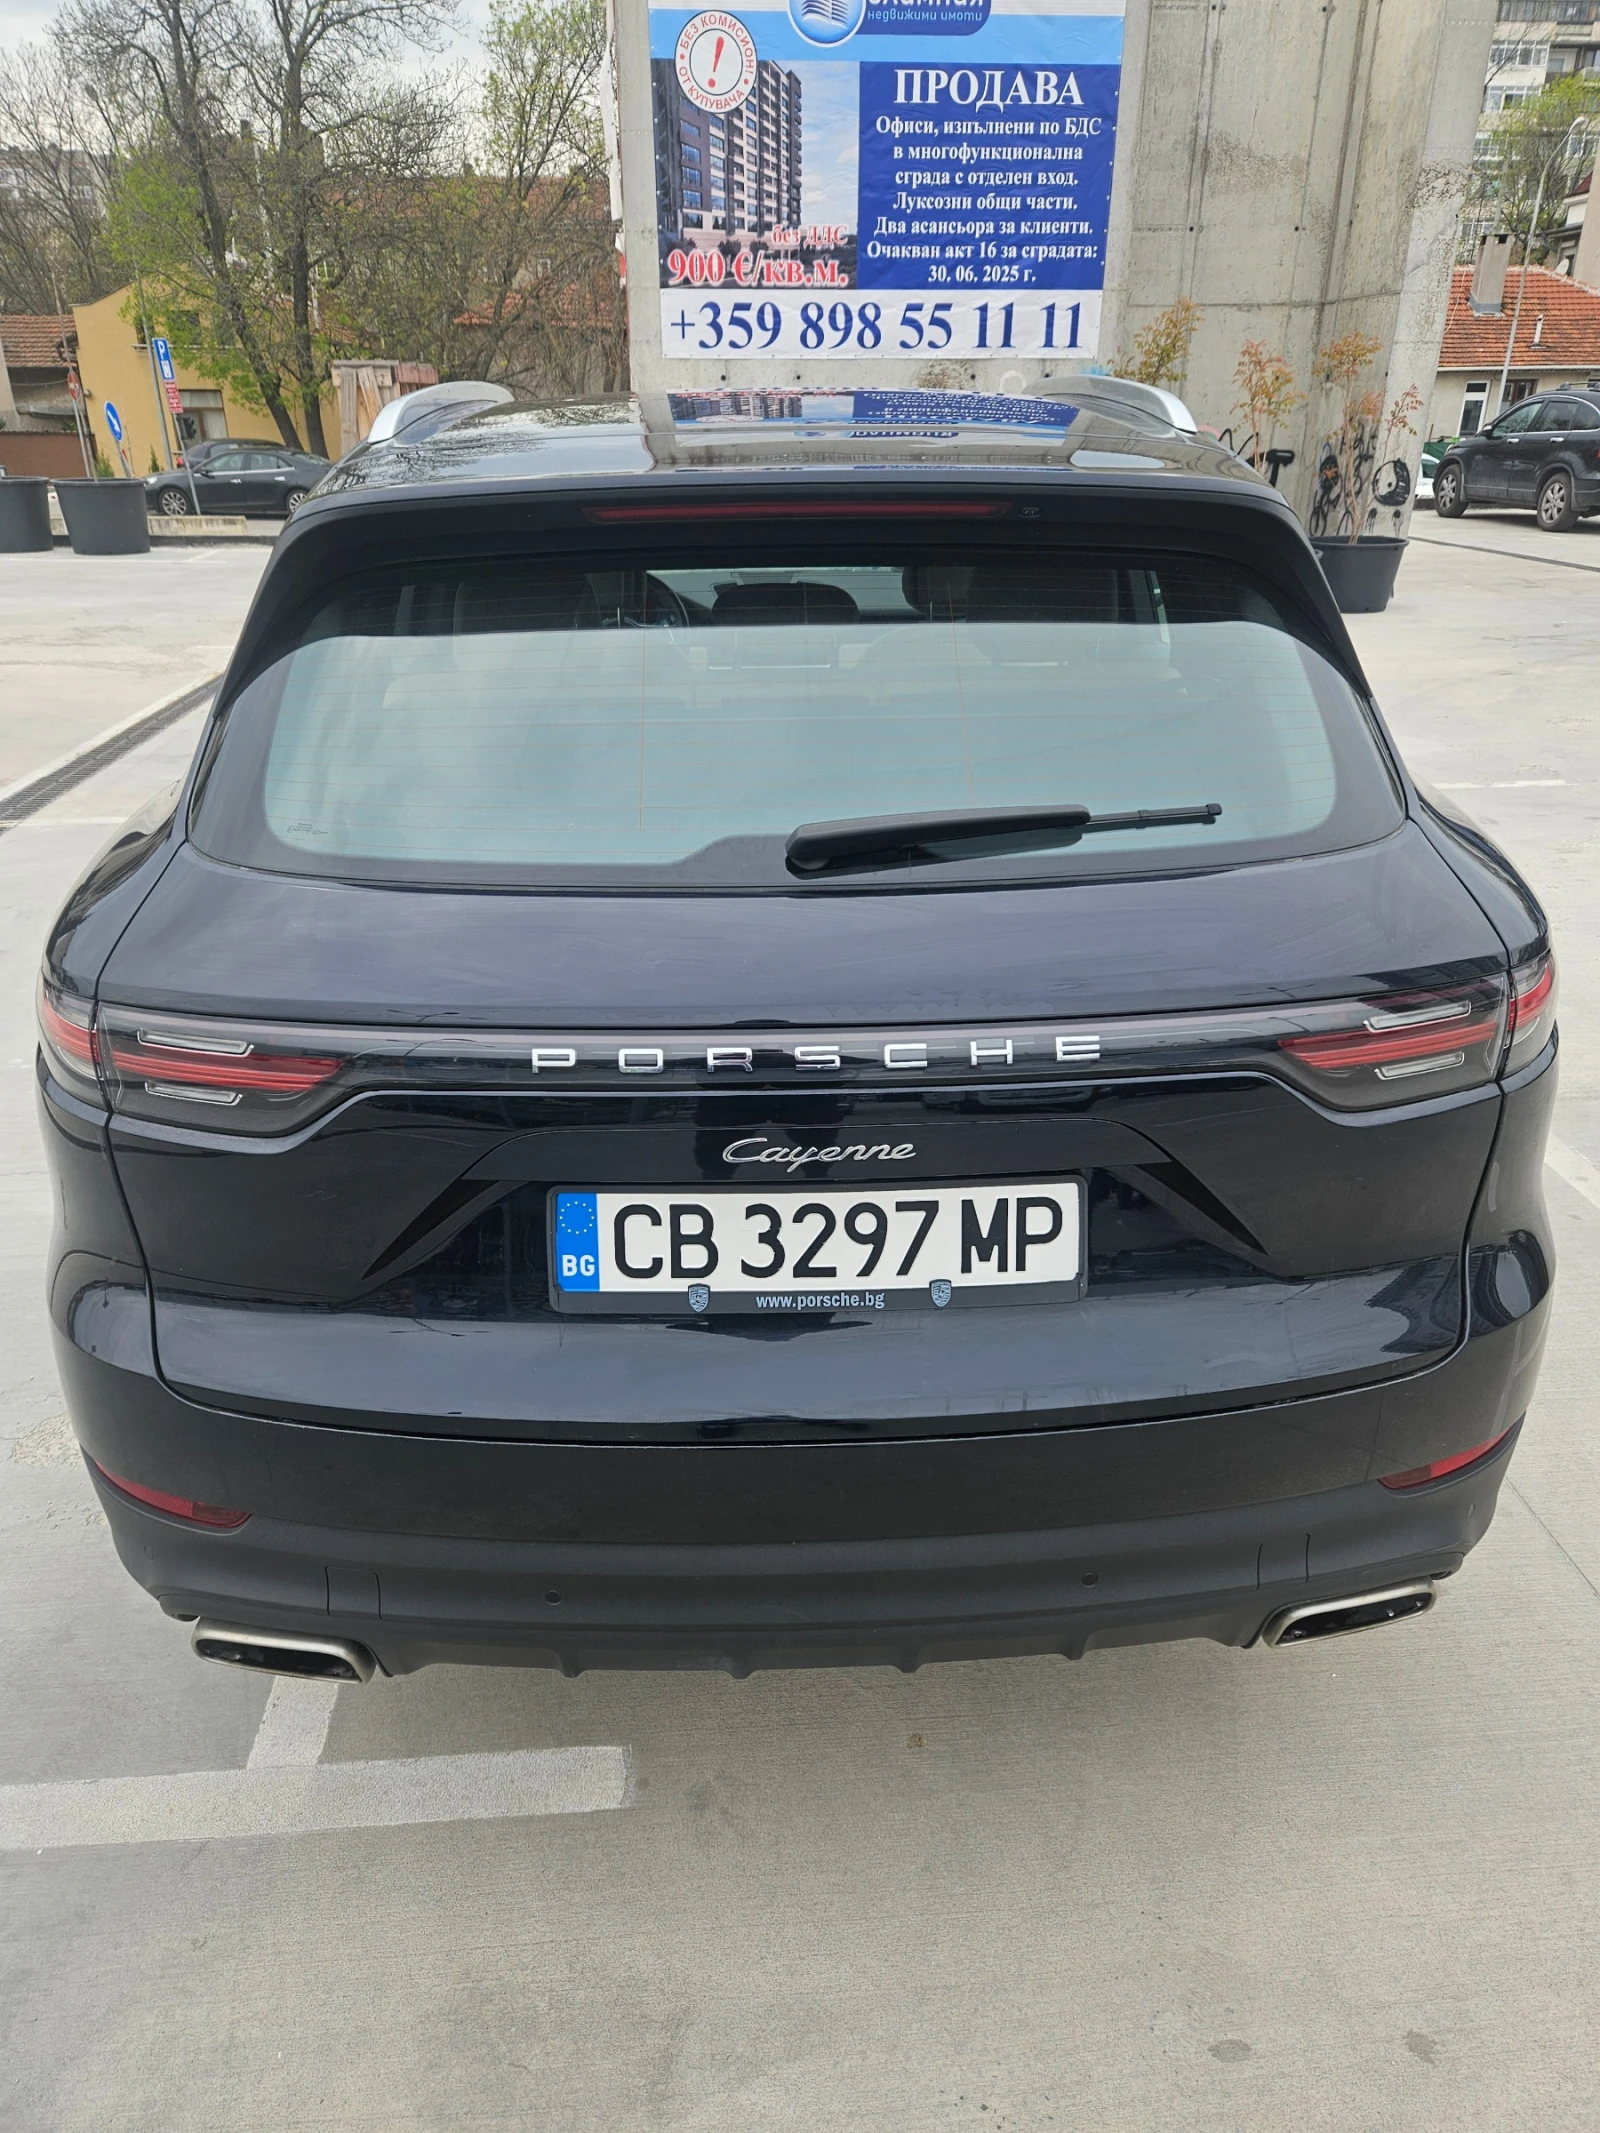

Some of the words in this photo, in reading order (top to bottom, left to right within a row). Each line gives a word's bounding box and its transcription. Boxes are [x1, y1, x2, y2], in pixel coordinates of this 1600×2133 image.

[867, 8, 937, 22] недвижими
[940, 11, 982, 21] имоти
[680, 23, 699, 50] БЕЗ
[700, 14, 755, 75] КОМИСИОН!
[679, 66, 692, 84] ОТ
[687, 89, 745, 110] КУПУВАЧА
[893, 69, 1085, 114] ПРОДАВА
[875, 115, 939, 138] Офиси,
[943, 121, 1035, 135] изпълнени
[1039, 121, 1060, 135] по
[1064, 117, 1102, 139] БДС
[893, 146, 904, 160] в
[908, 142, 1083, 164] многофункционална
[895, 172, 950, 189] сграда
[954, 172, 963, 185] с
[967, 172, 1032, 187] отделен
[1037, 171, 1079, 187] вход.
[892, 192, 972, 214] Луксозни
[976, 192, 1023, 212] общи
[1026, 196, 1078, 210] части.
[771, 224, 801, 244] без
[803, 224, 849, 250] ДДС
[873, 216, 906, 237] Два
[910, 221, 995, 238] асансьора
[998, 221, 1016, 234] за
[1019, 221, 1093, 235] клиенти.
[866, 241, 941, 259] Очакван
[945, 245, 974, 259] акт
[978, 241, 997, 259] 16
[1000, 245, 1018, 259] за
[1021, 245, 1098, 262] сградата:
[668, 249, 726, 286] 900
[733, 249, 849, 287] €/кв.м.
[927, 265, 951, 283] 30.
[955, 265, 979, 283] 06.
[982, 264, 1020, 283] 2025
[1023, 268, 1037, 283] г.
[670, 301, 782, 349] +359
[799, 301, 882, 350] 898
[899, 302, 953, 349] 55
[972, 301, 1017, 349] 11
[1039, 301, 1083, 349] 11
[531, 1034, 1101, 1074] PORSCHE
[721, 1137, 917, 1174] Cayenne
[613, 1202, 720, 1279] CB
[740, 1199, 940, 1279] 3297
[960, 1196, 1063, 1274] MP
[561, 1254, 595, 1278] BG
[755, 1291, 886, 1311] www.porsche.bg
